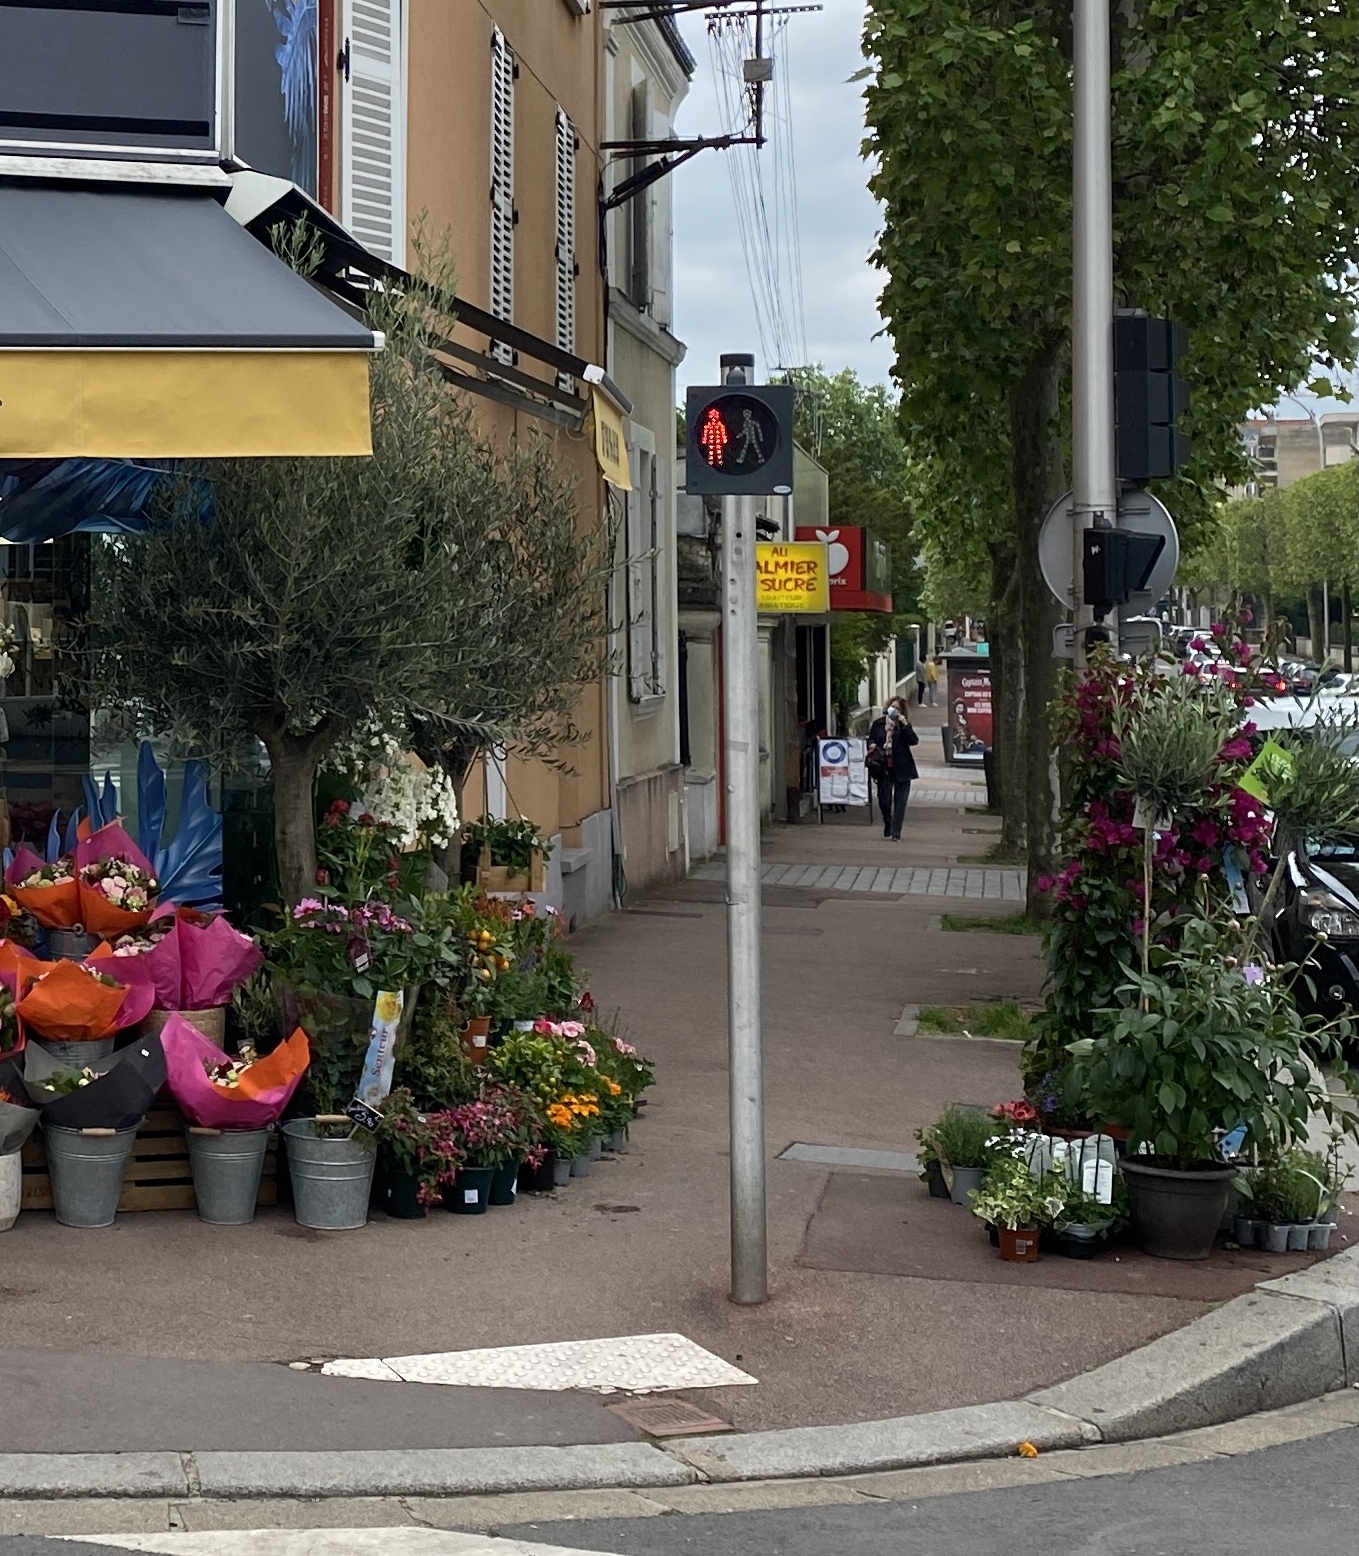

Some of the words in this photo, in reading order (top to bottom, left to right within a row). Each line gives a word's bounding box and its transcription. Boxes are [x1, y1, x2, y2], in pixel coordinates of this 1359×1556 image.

[772, 547, 788, 557] AU
[756, 560, 818, 574] ALMIER
[371, 1027, 389, 1077] Senteur
